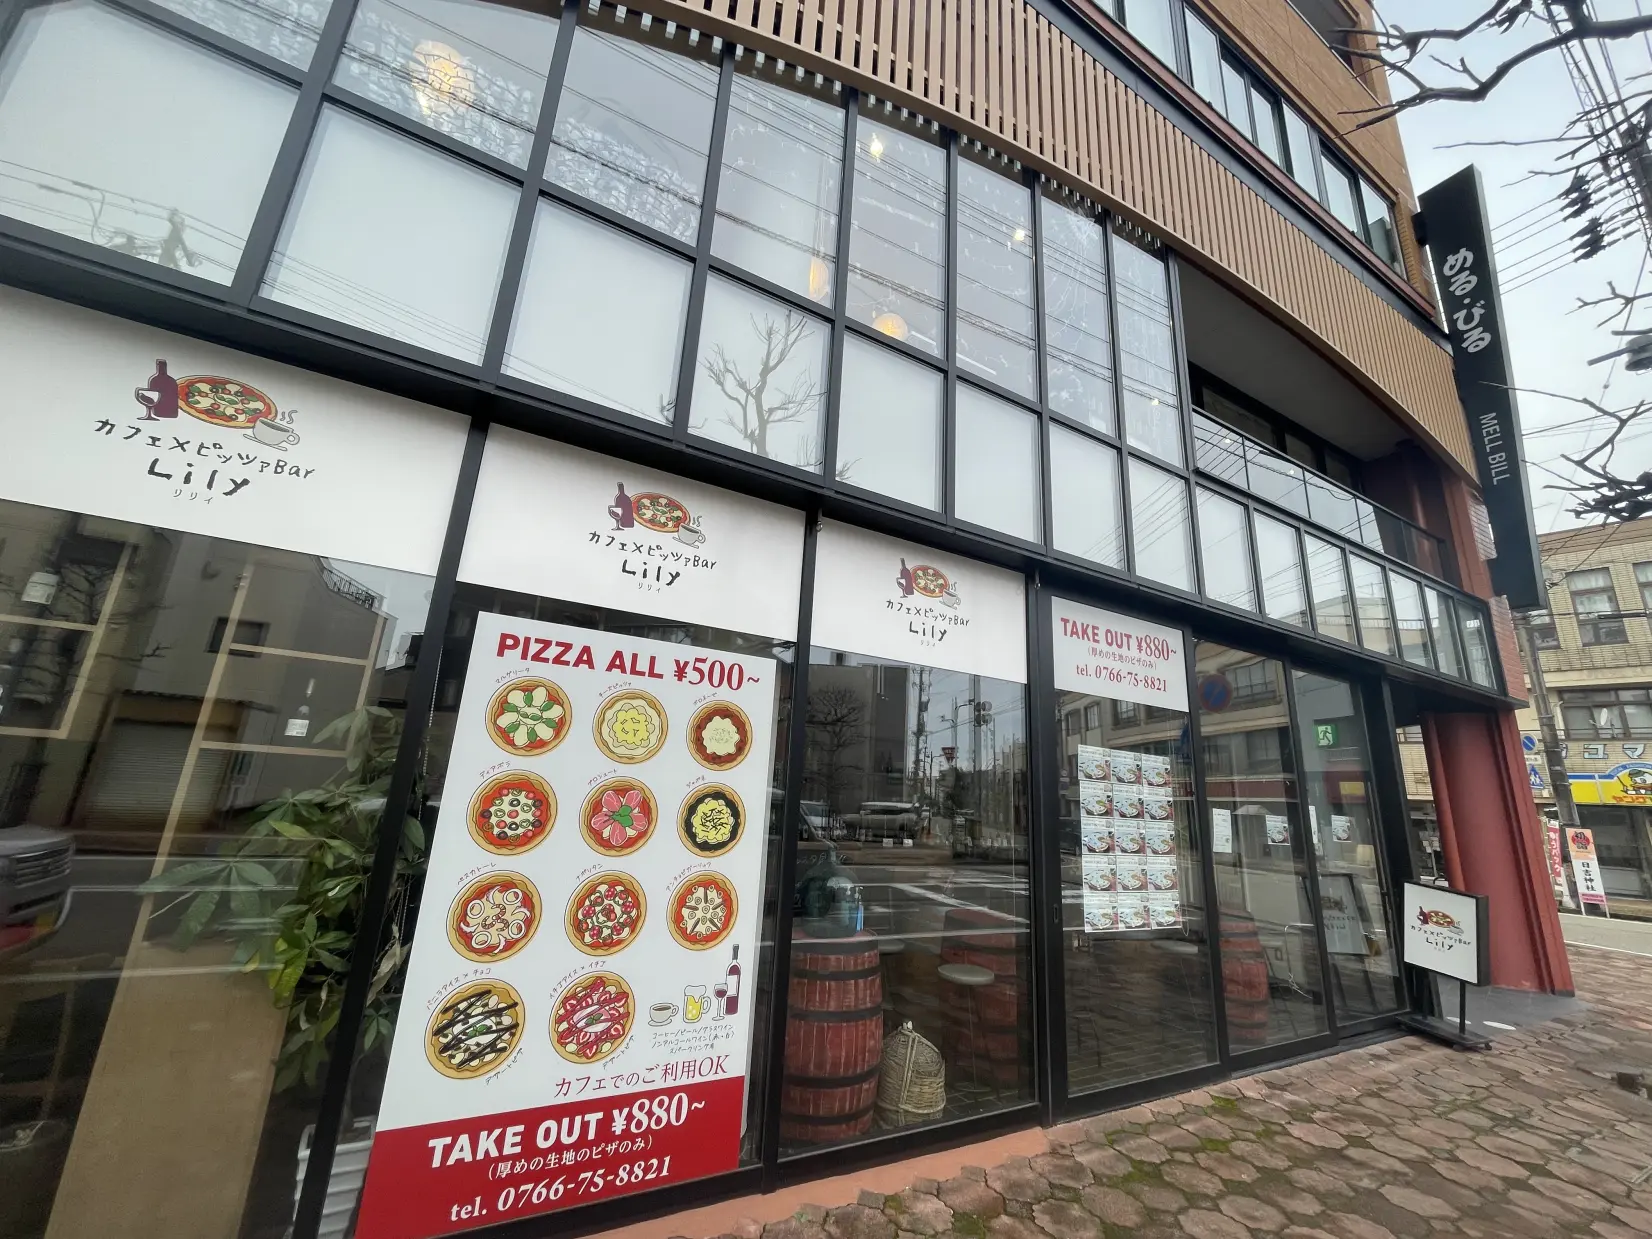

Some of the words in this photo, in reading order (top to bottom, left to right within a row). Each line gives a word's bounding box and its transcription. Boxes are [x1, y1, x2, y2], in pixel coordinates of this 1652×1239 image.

[1443, 247, 1492, 353] める・びる
[1479, 412, 1503, 452] MELL
[147, 457, 251, 496] Lily
[1488, 452, 1510, 485] BILL
[621, 560, 681, 586] Lily
[909, 620, 947, 641] Lily
[1060, 617, 1100, 644] TAKE
[1104, 628, 1132, 651] OUT
[496, 633, 595, 670] PIZZA
[605, 650, 664, 680] ALL
[1076, 664, 1092, 677] tel.
[1095, 665, 1167, 692] 0766-75-8821
[1425, 937, 1453, 950] Lily
[554, 1055, 729, 1098] カフェでのご利用OK
[428, 1125, 524, 1169] TAKE
[536, 1111, 603, 1149] OUT
[450, 1197, 487, 1221] tel.
[498, 1155, 671, 1211] 0766-75-8821
